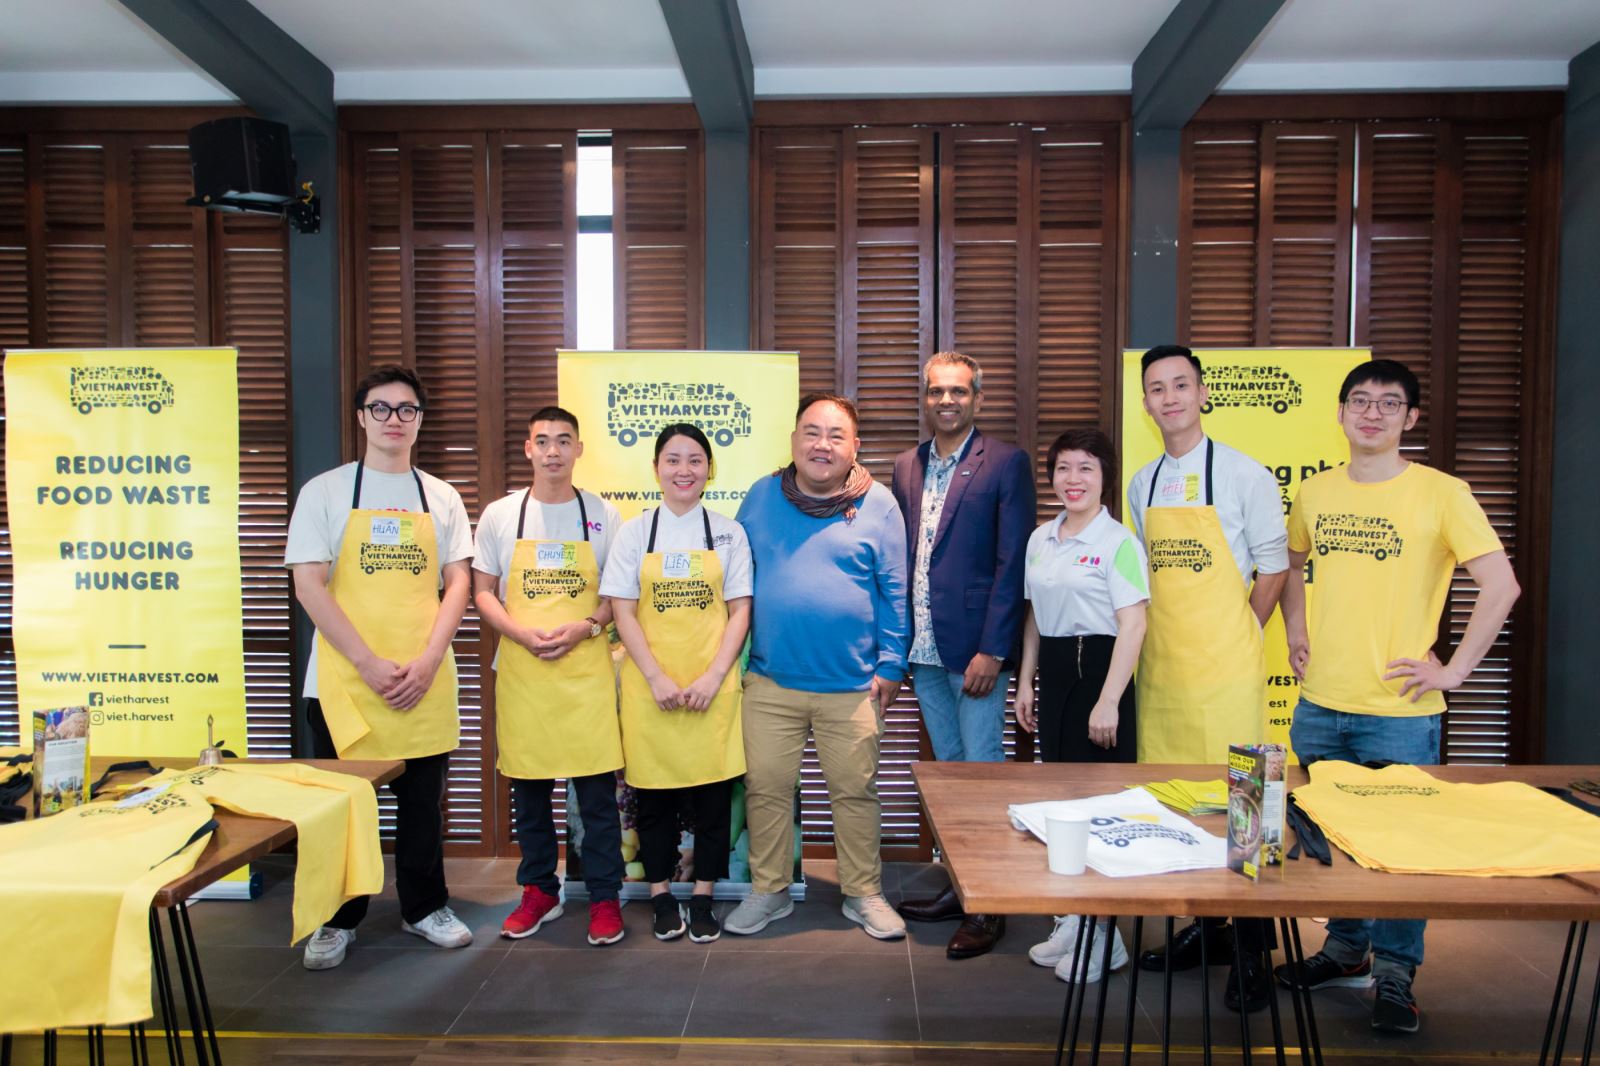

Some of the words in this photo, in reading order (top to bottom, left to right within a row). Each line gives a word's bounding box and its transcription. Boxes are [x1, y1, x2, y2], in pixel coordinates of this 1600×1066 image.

[80, 382, 159, 391] VIETHARVEST
[621, 404, 731, 417] VIETHARVEST
[56, 455, 191, 475] REDUCING
[37, 486, 112, 505] FOOD
[122, 485, 211, 505] WASTE
[1322, 529, 1388, 540] VIETHARVEST
[60, 541, 193, 560] REDUCING
[75, 571, 180, 590] HUNGER
[657, 589, 707, 598] VIETHARVEST
[42, 672, 219, 684] WWW.VIETHARVEST.COM
[106, 695, 170, 704] vietharvest
[106, 712, 174, 722] viet.harvest
